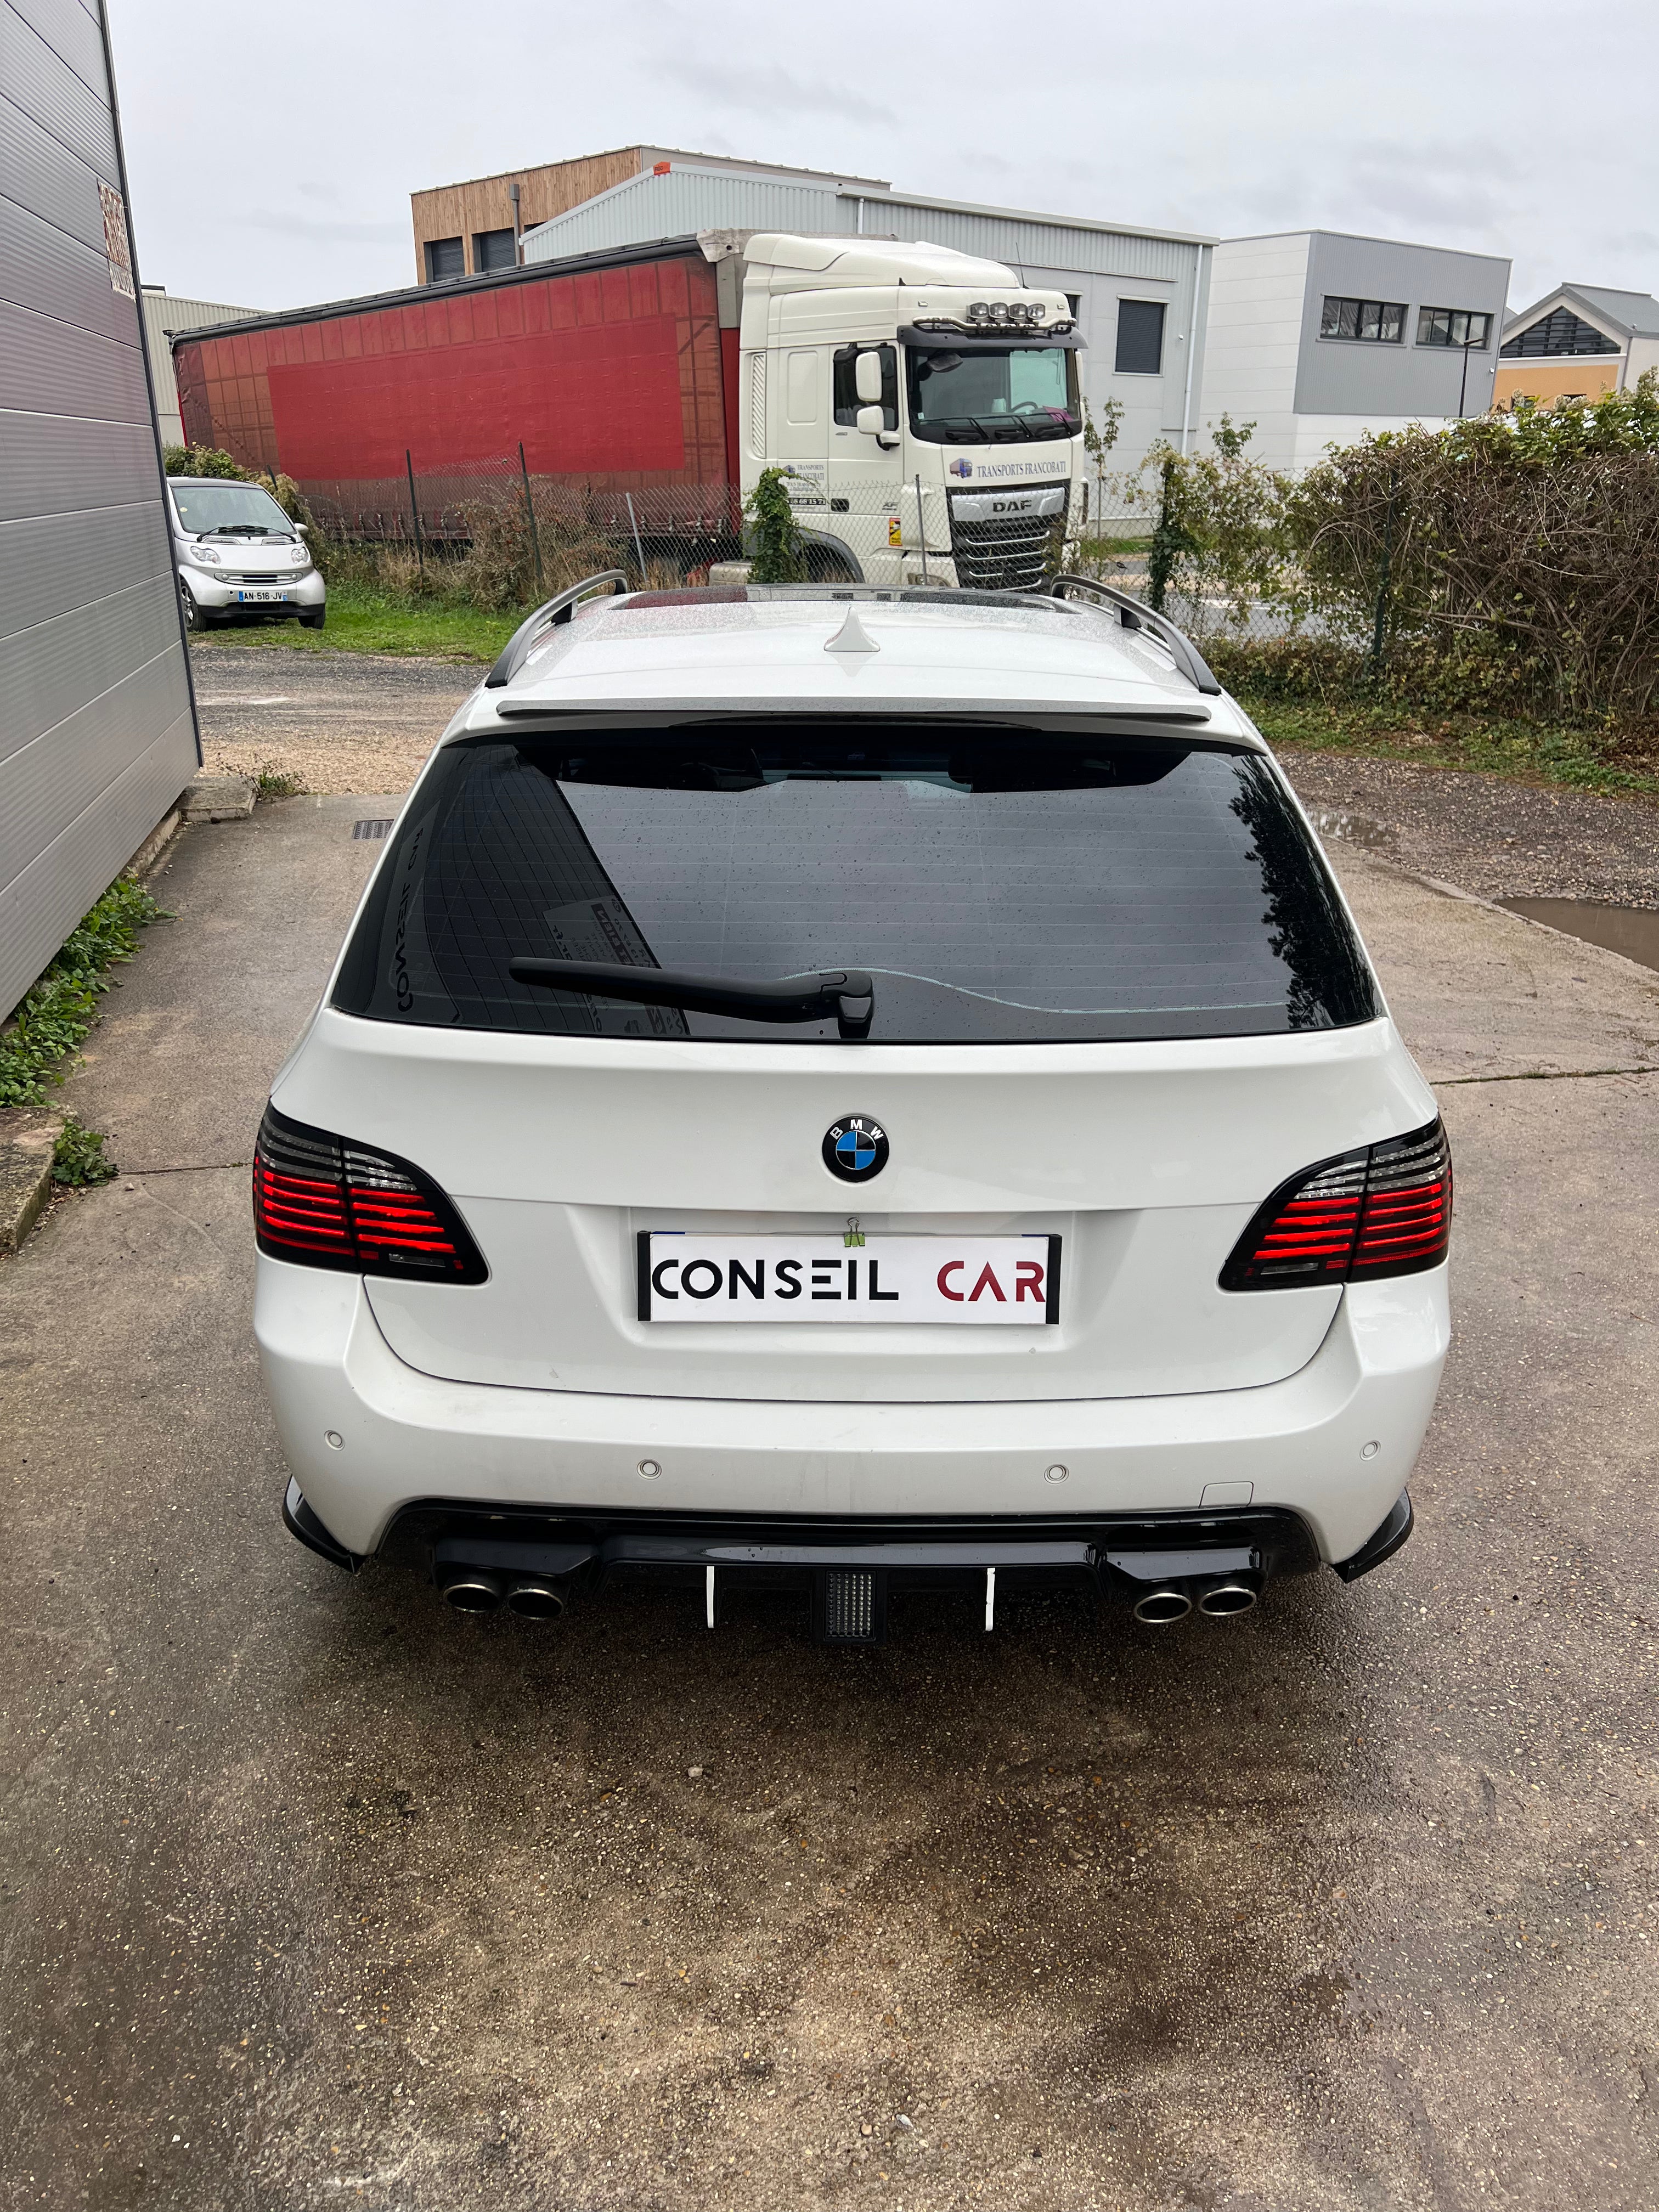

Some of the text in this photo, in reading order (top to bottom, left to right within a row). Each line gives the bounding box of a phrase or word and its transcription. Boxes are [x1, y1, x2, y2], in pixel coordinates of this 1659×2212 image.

[977, 461, 1066, 477] TRANSPORTS FRANCOBATI
[993, 499, 1031, 512] DAF
[830, 1119, 884, 1141] BMW
[652, 1259, 1046, 1302] CONSEIL CAR
